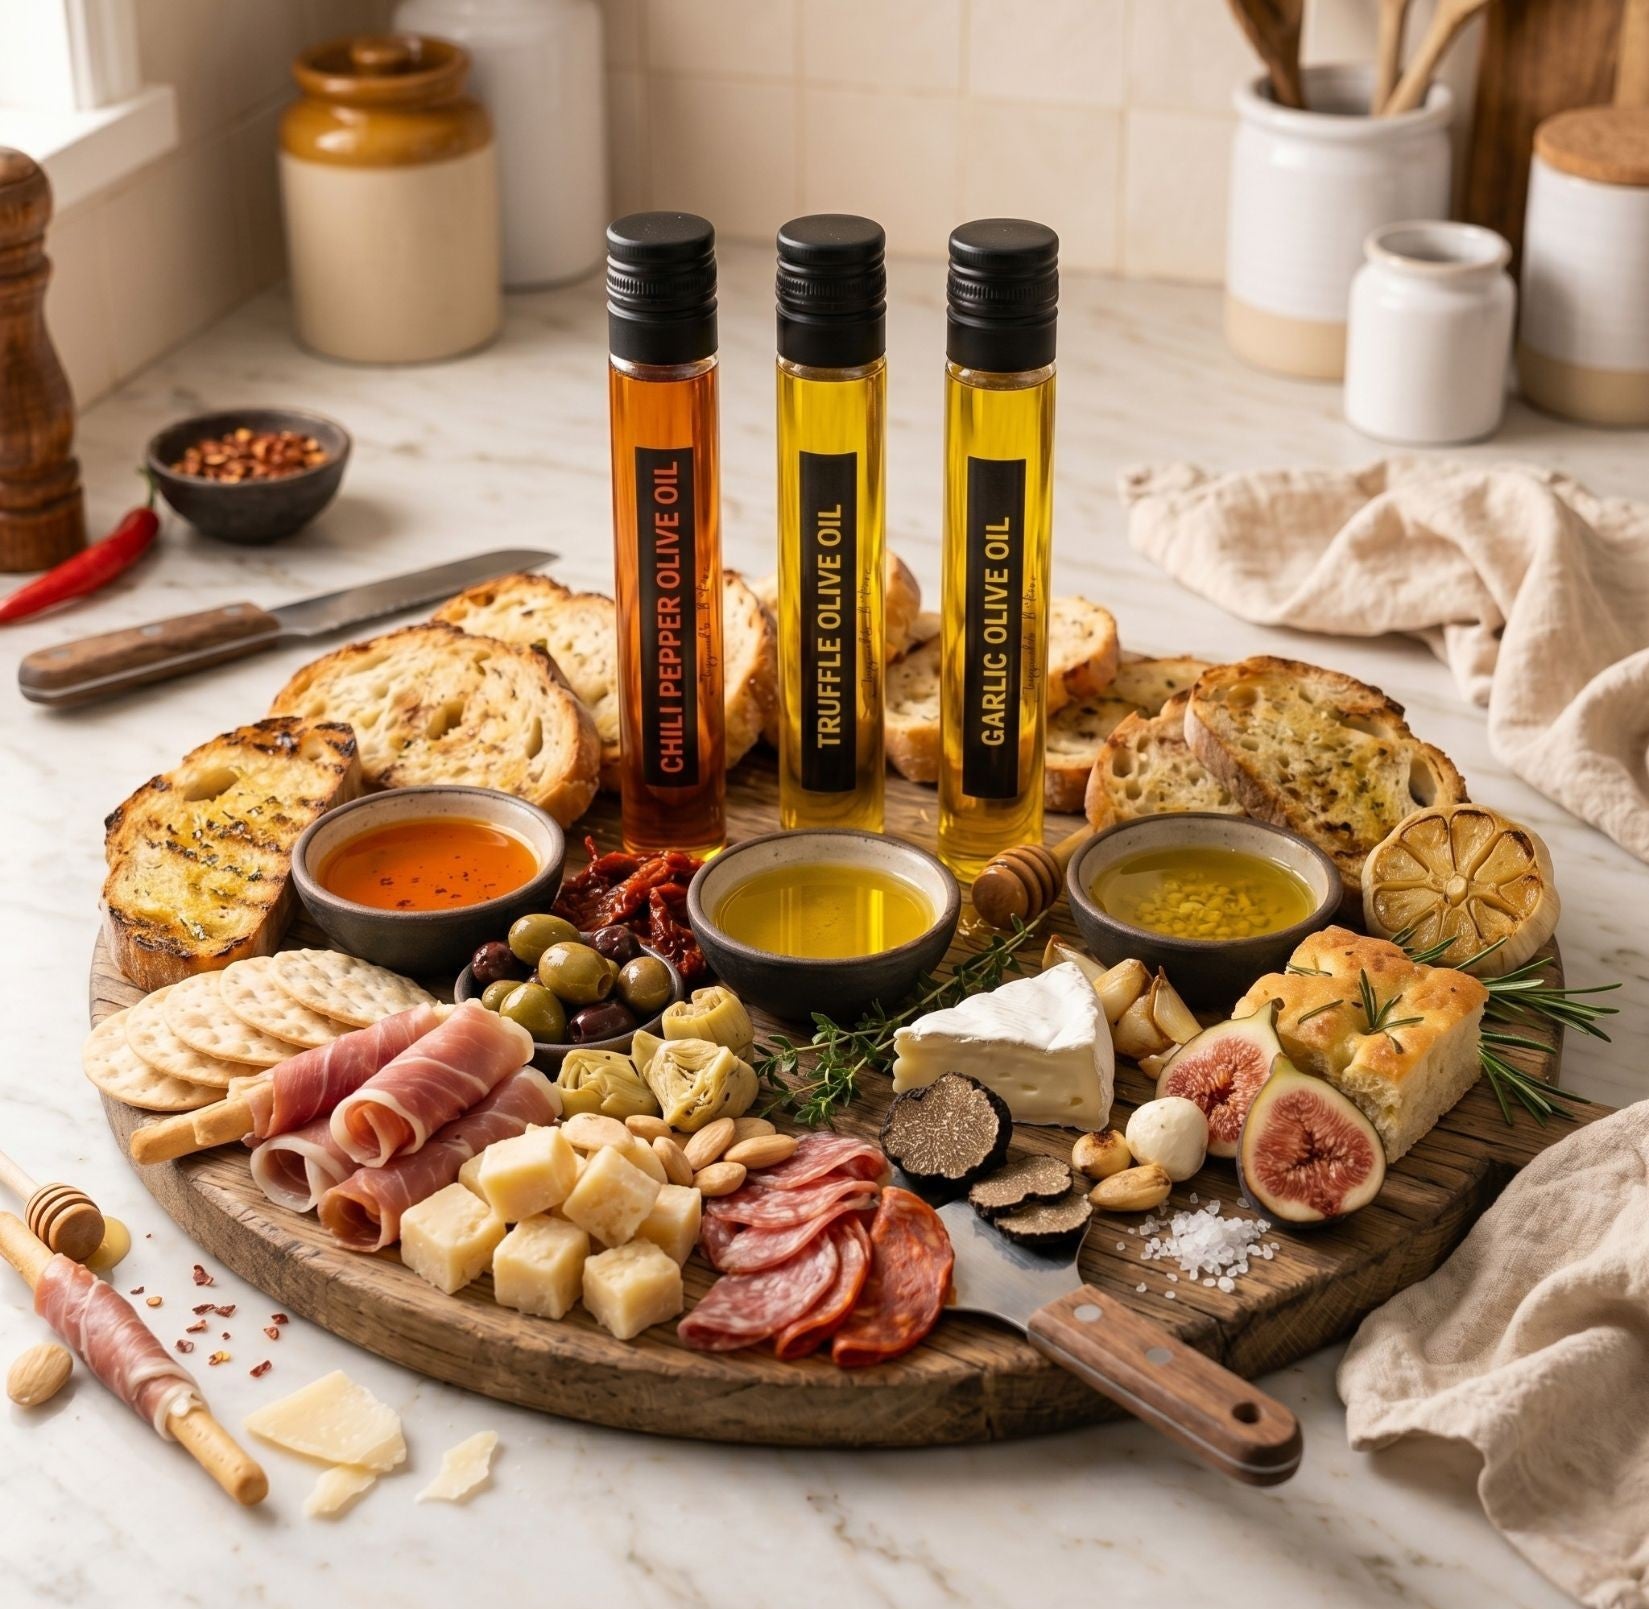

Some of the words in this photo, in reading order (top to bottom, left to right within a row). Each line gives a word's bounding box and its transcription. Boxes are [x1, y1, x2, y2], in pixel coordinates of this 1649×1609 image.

[653, 461, 678, 505] OIL
[654, 512, 681, 590] OLIVE
[817, 504, 842, 547] OIL
[984, 516, 1010, 561] OIL
[817, 554, 841, 630] OLIVE
[983, 568, 1009, 645] OLIVE
[656, 596, 682, 697] PEPPER
[817, 637, 841, 748] TRUFFLE
[981, 653, 1008, 747] GARLIC
[660, 706, 683, 773] CHILI
